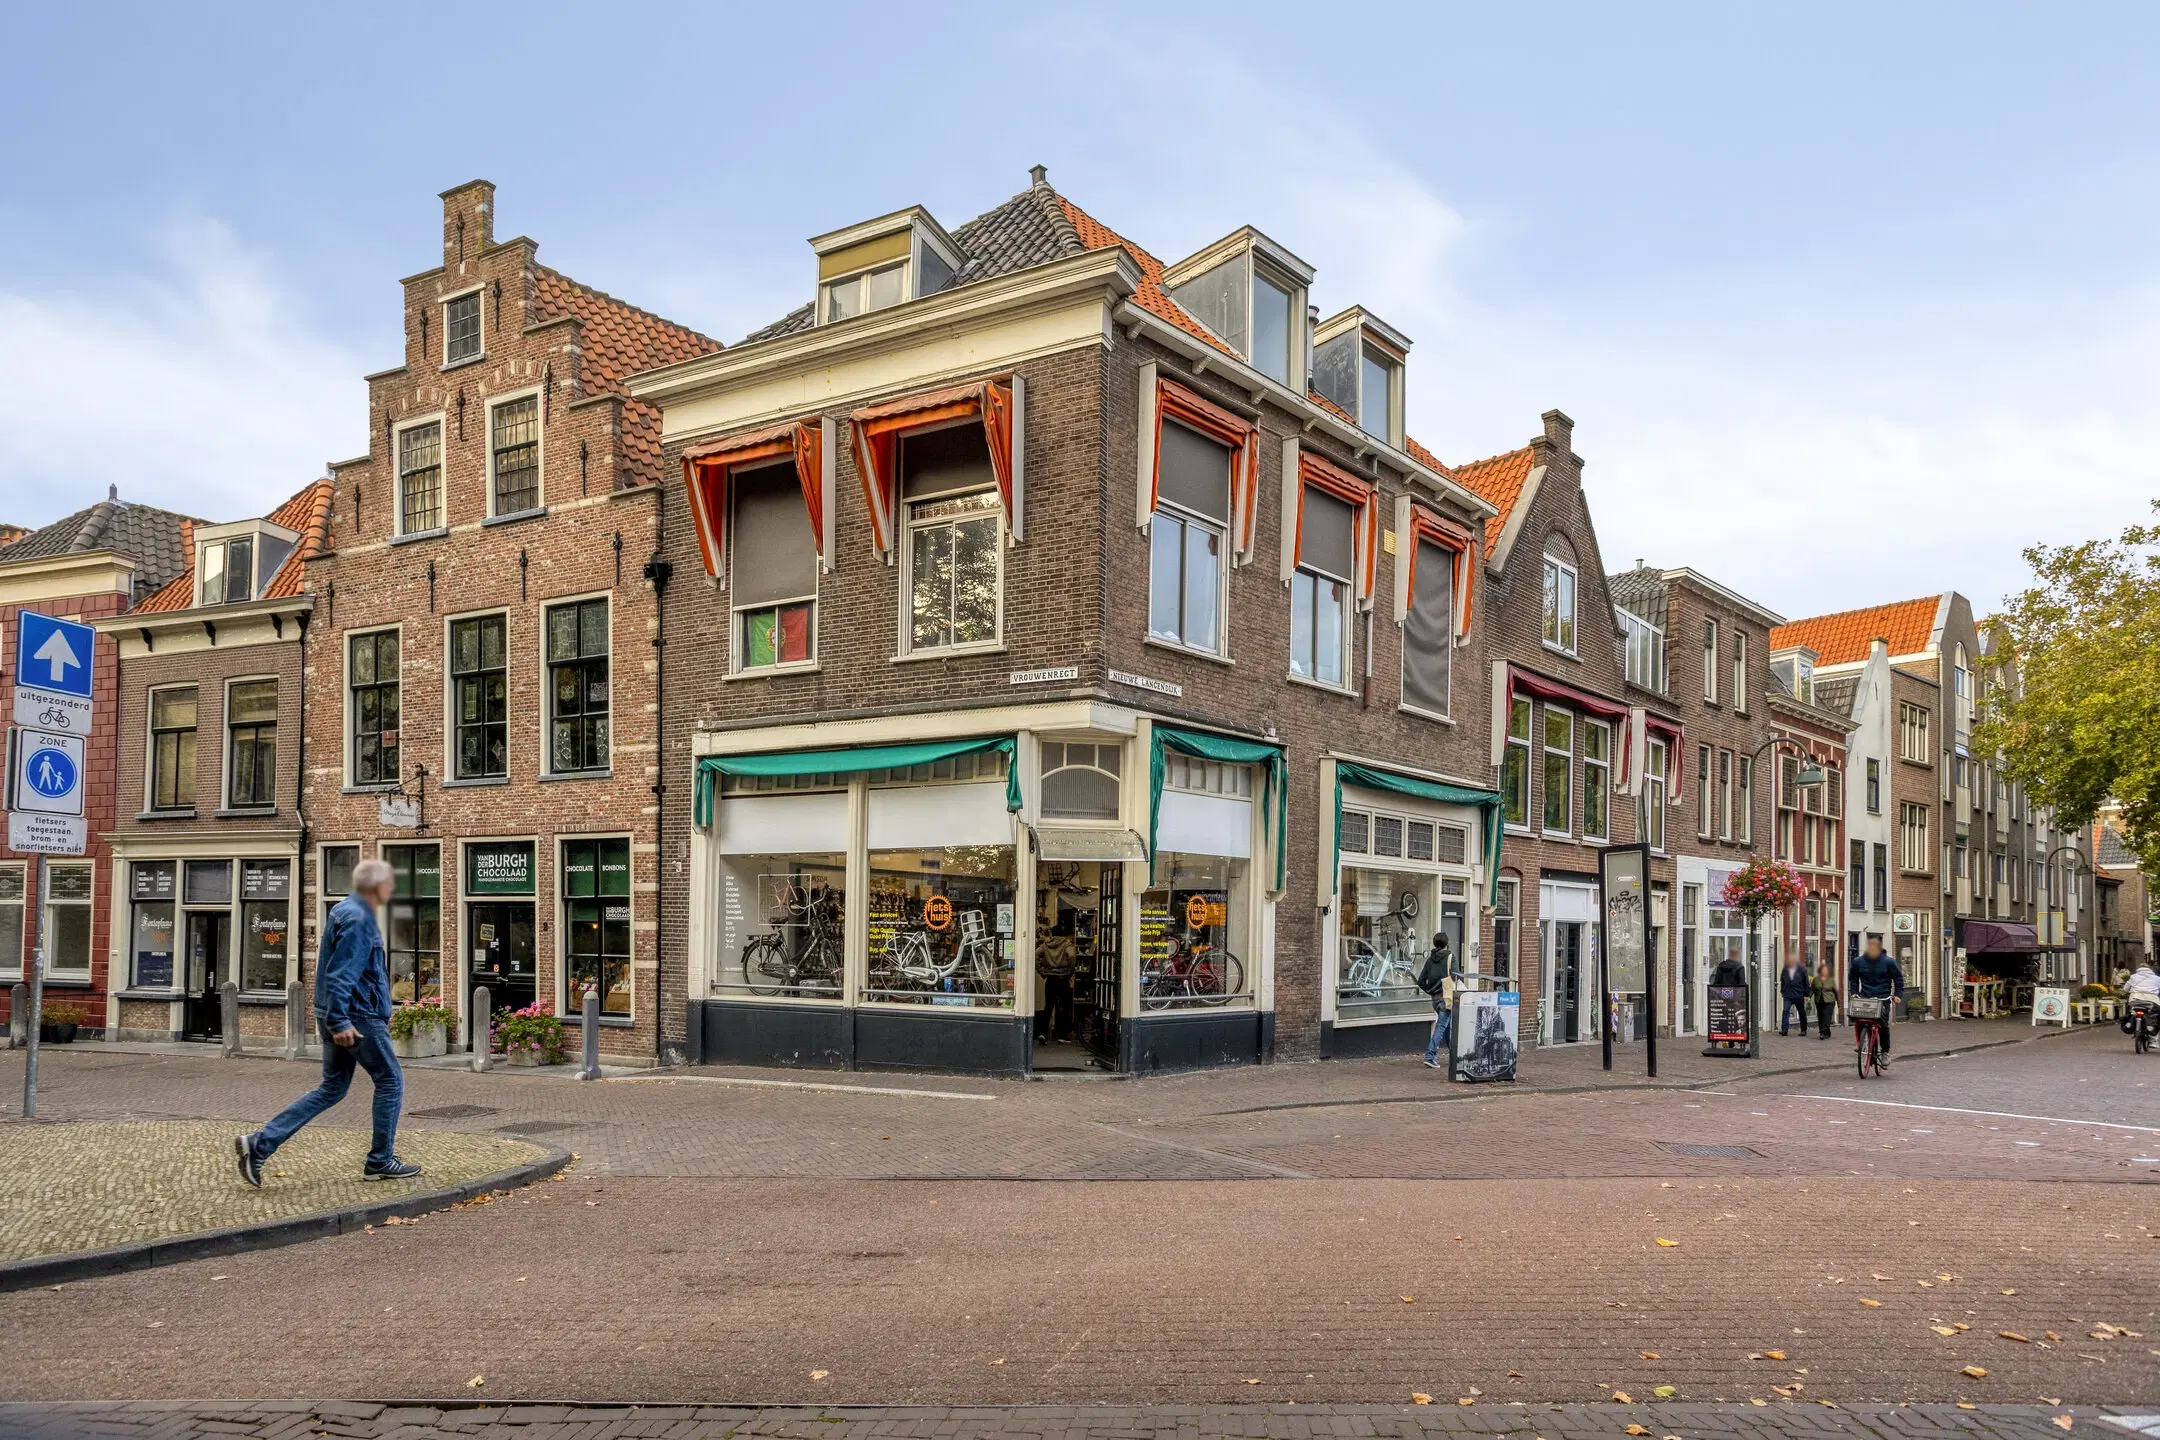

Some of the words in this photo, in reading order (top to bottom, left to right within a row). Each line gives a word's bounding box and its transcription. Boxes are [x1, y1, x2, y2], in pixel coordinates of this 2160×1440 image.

[1113, 672, 1138, 685] NIEUWE
[20, 691, 90, 711] uitgezonderd
[39, 736, 67, 748] ZONE
[35, 816, 67, 826] fietsers
[31, 834, 55, 843] brom-
[15, 843, 65, 853] snorfietsers
[488, 853, 527, 868] BURGH
[477, 868, 527, 877] CHOCOLAAD
[927, 902, 949, 912] fiets
[930, 911, 949, 921] huis
